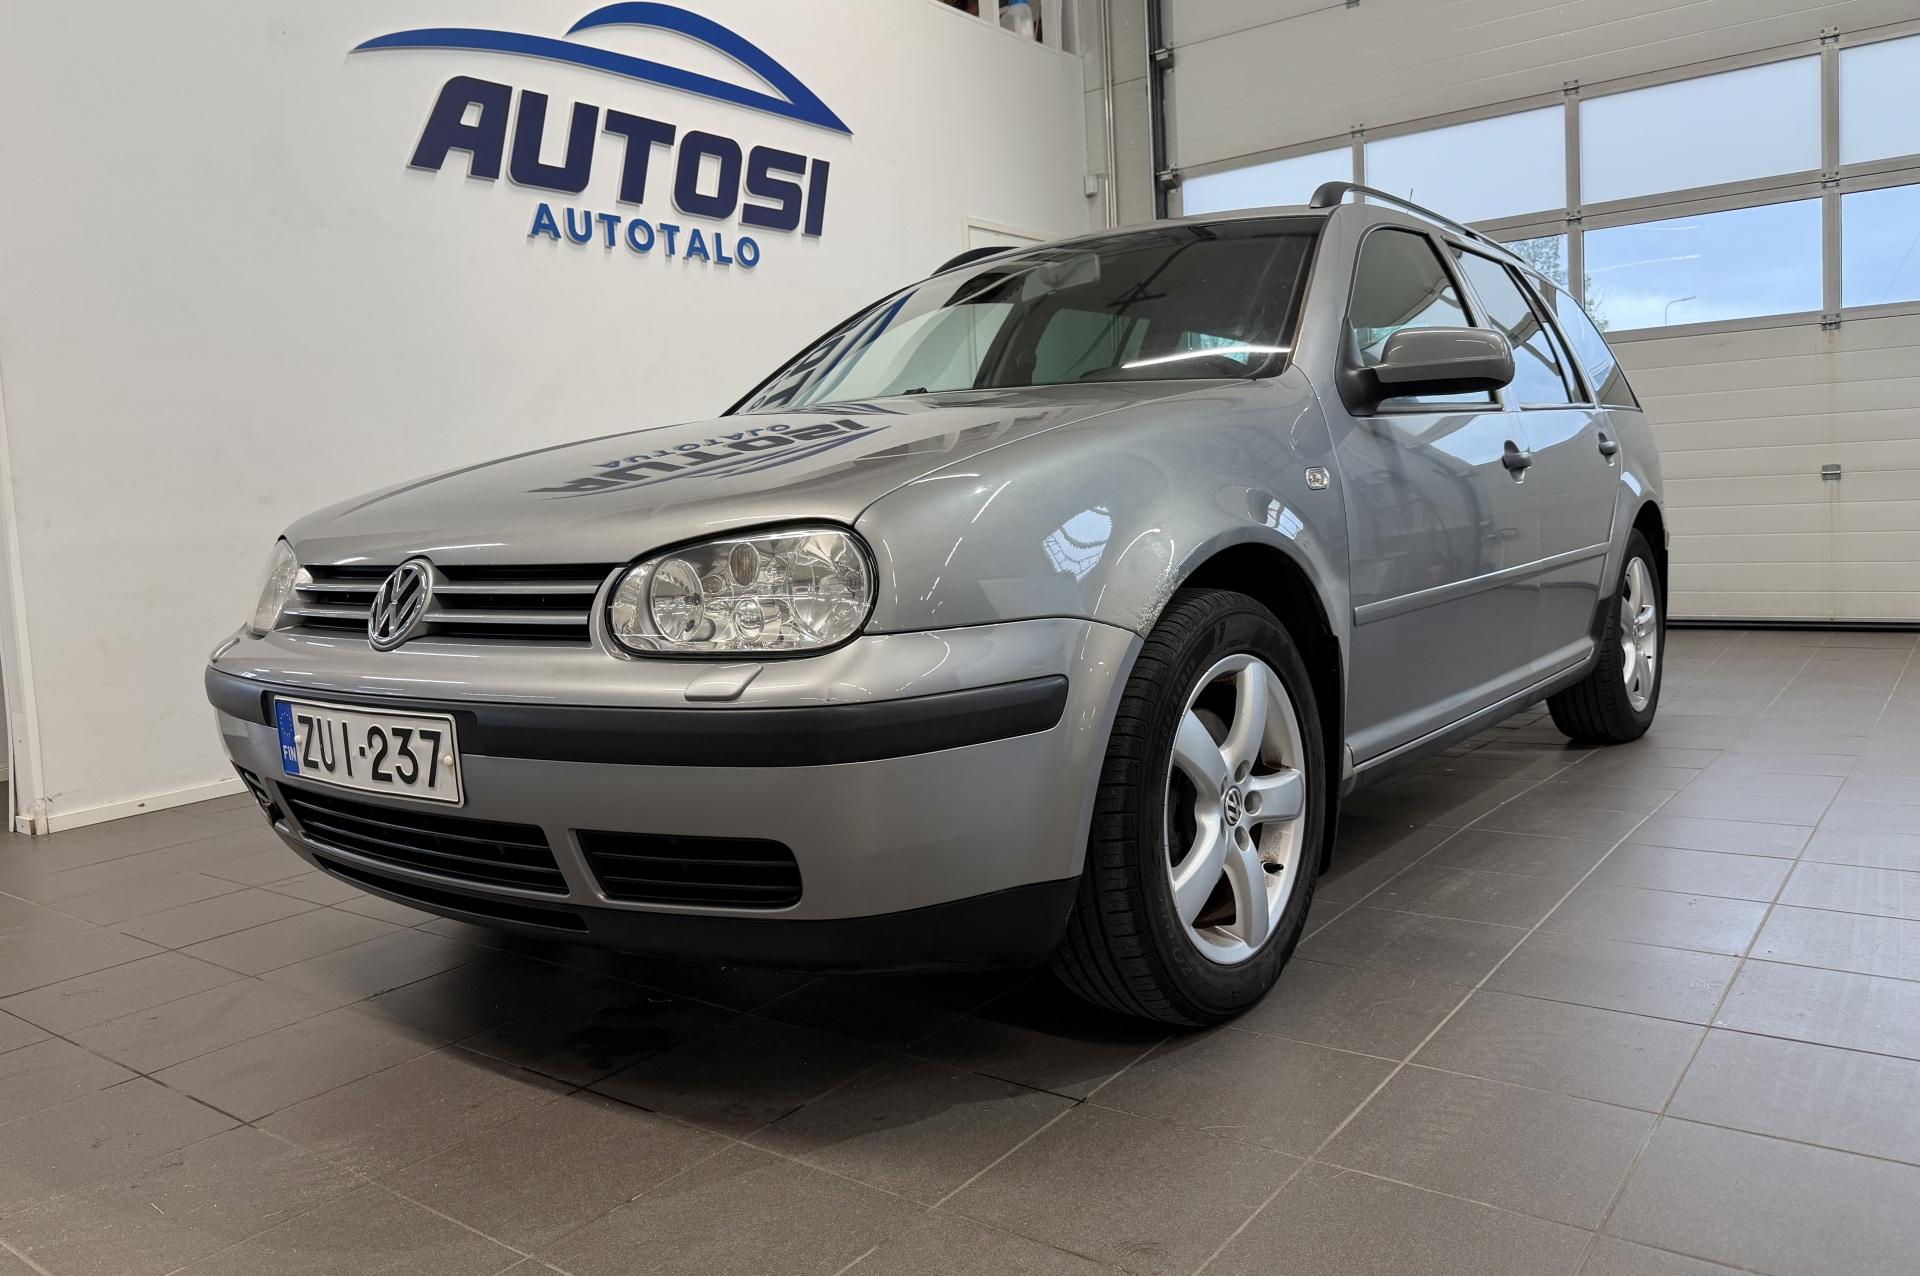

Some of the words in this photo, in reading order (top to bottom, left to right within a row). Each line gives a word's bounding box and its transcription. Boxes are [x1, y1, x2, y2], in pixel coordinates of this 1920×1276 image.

[409, 76, 830, 236] AUTOSI
[530, 203, 761, 268] AUTOTALO
[283, 745, 297, 762] FIN
[297, 714, 442, 788] ZUI-237
